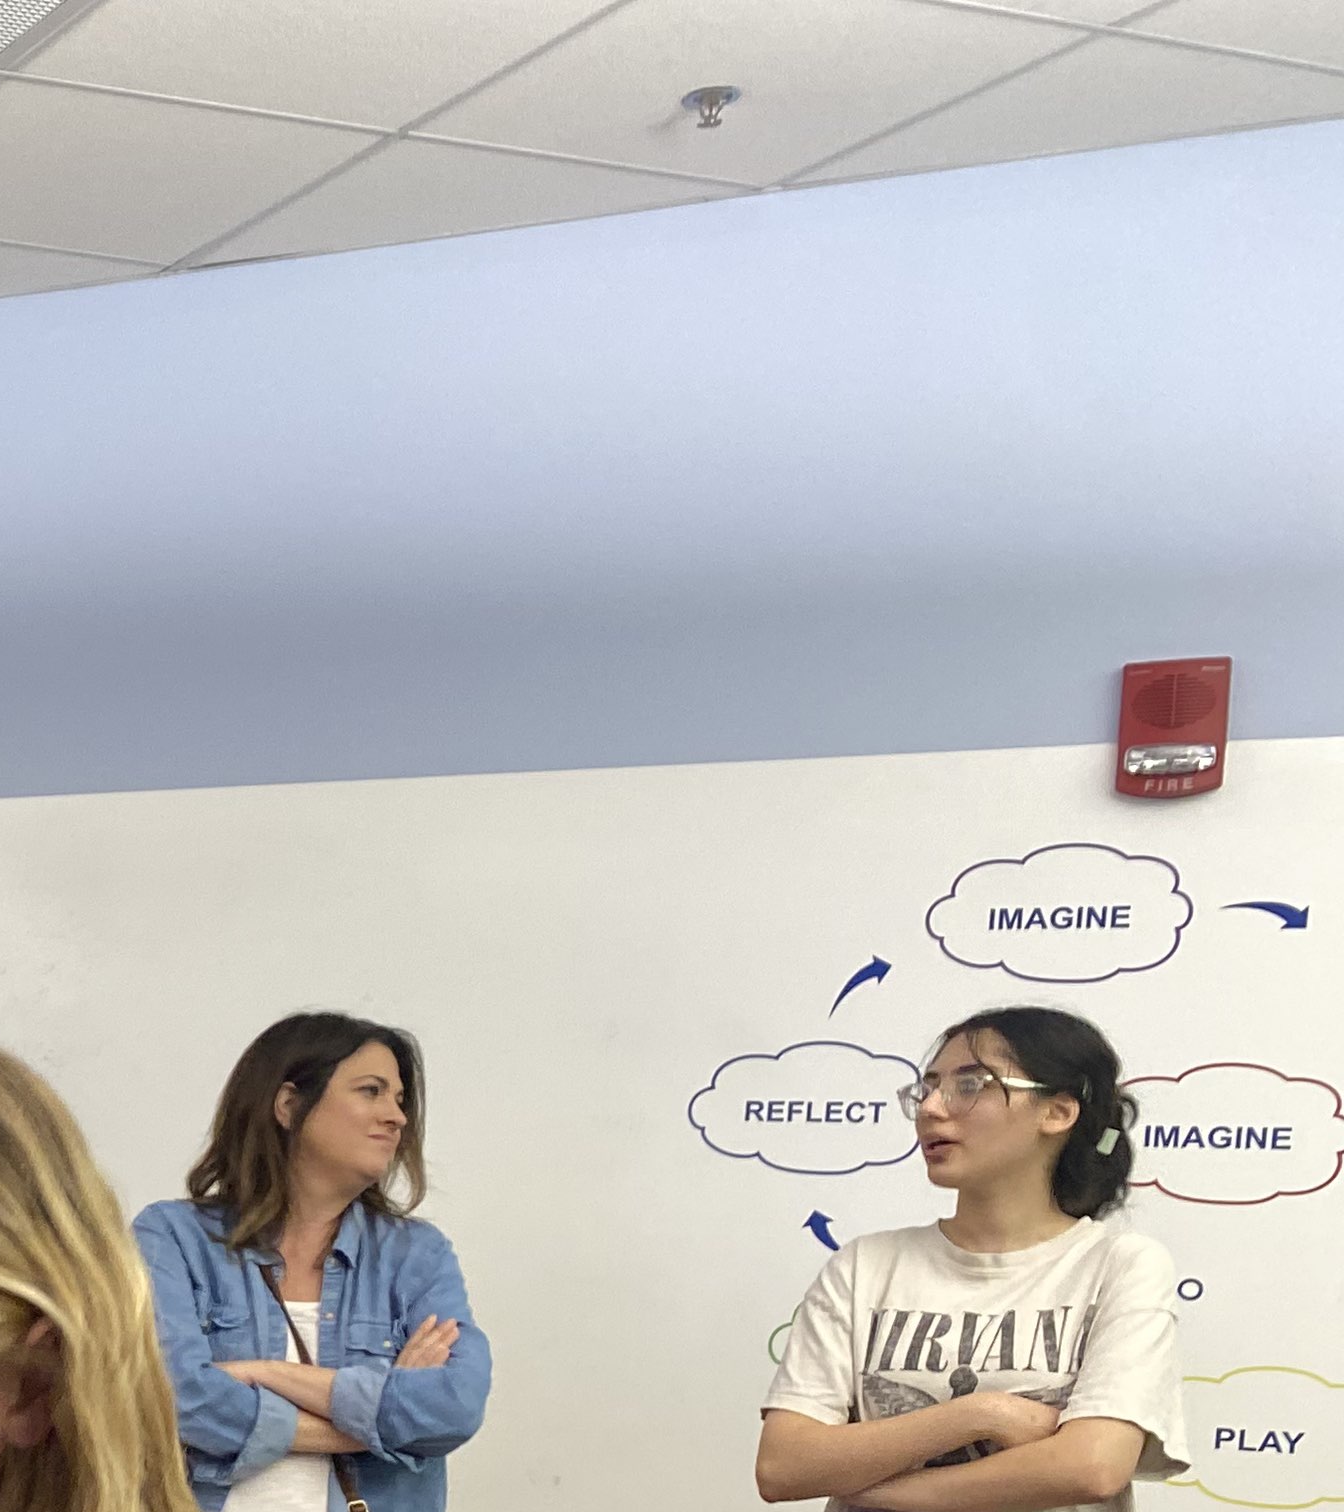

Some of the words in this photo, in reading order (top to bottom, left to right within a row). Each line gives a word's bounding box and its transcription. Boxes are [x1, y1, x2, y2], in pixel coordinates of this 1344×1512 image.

[1144, 777, 1195, 792] FIRE
[988, 905, 1132, 931] IMAGINE
[743, 1100, 888, 1124] REFLECT
[1142, 1124, 1293, 1151] IMAGINE
[1213, 1427, 1306, 1456] PLAY
